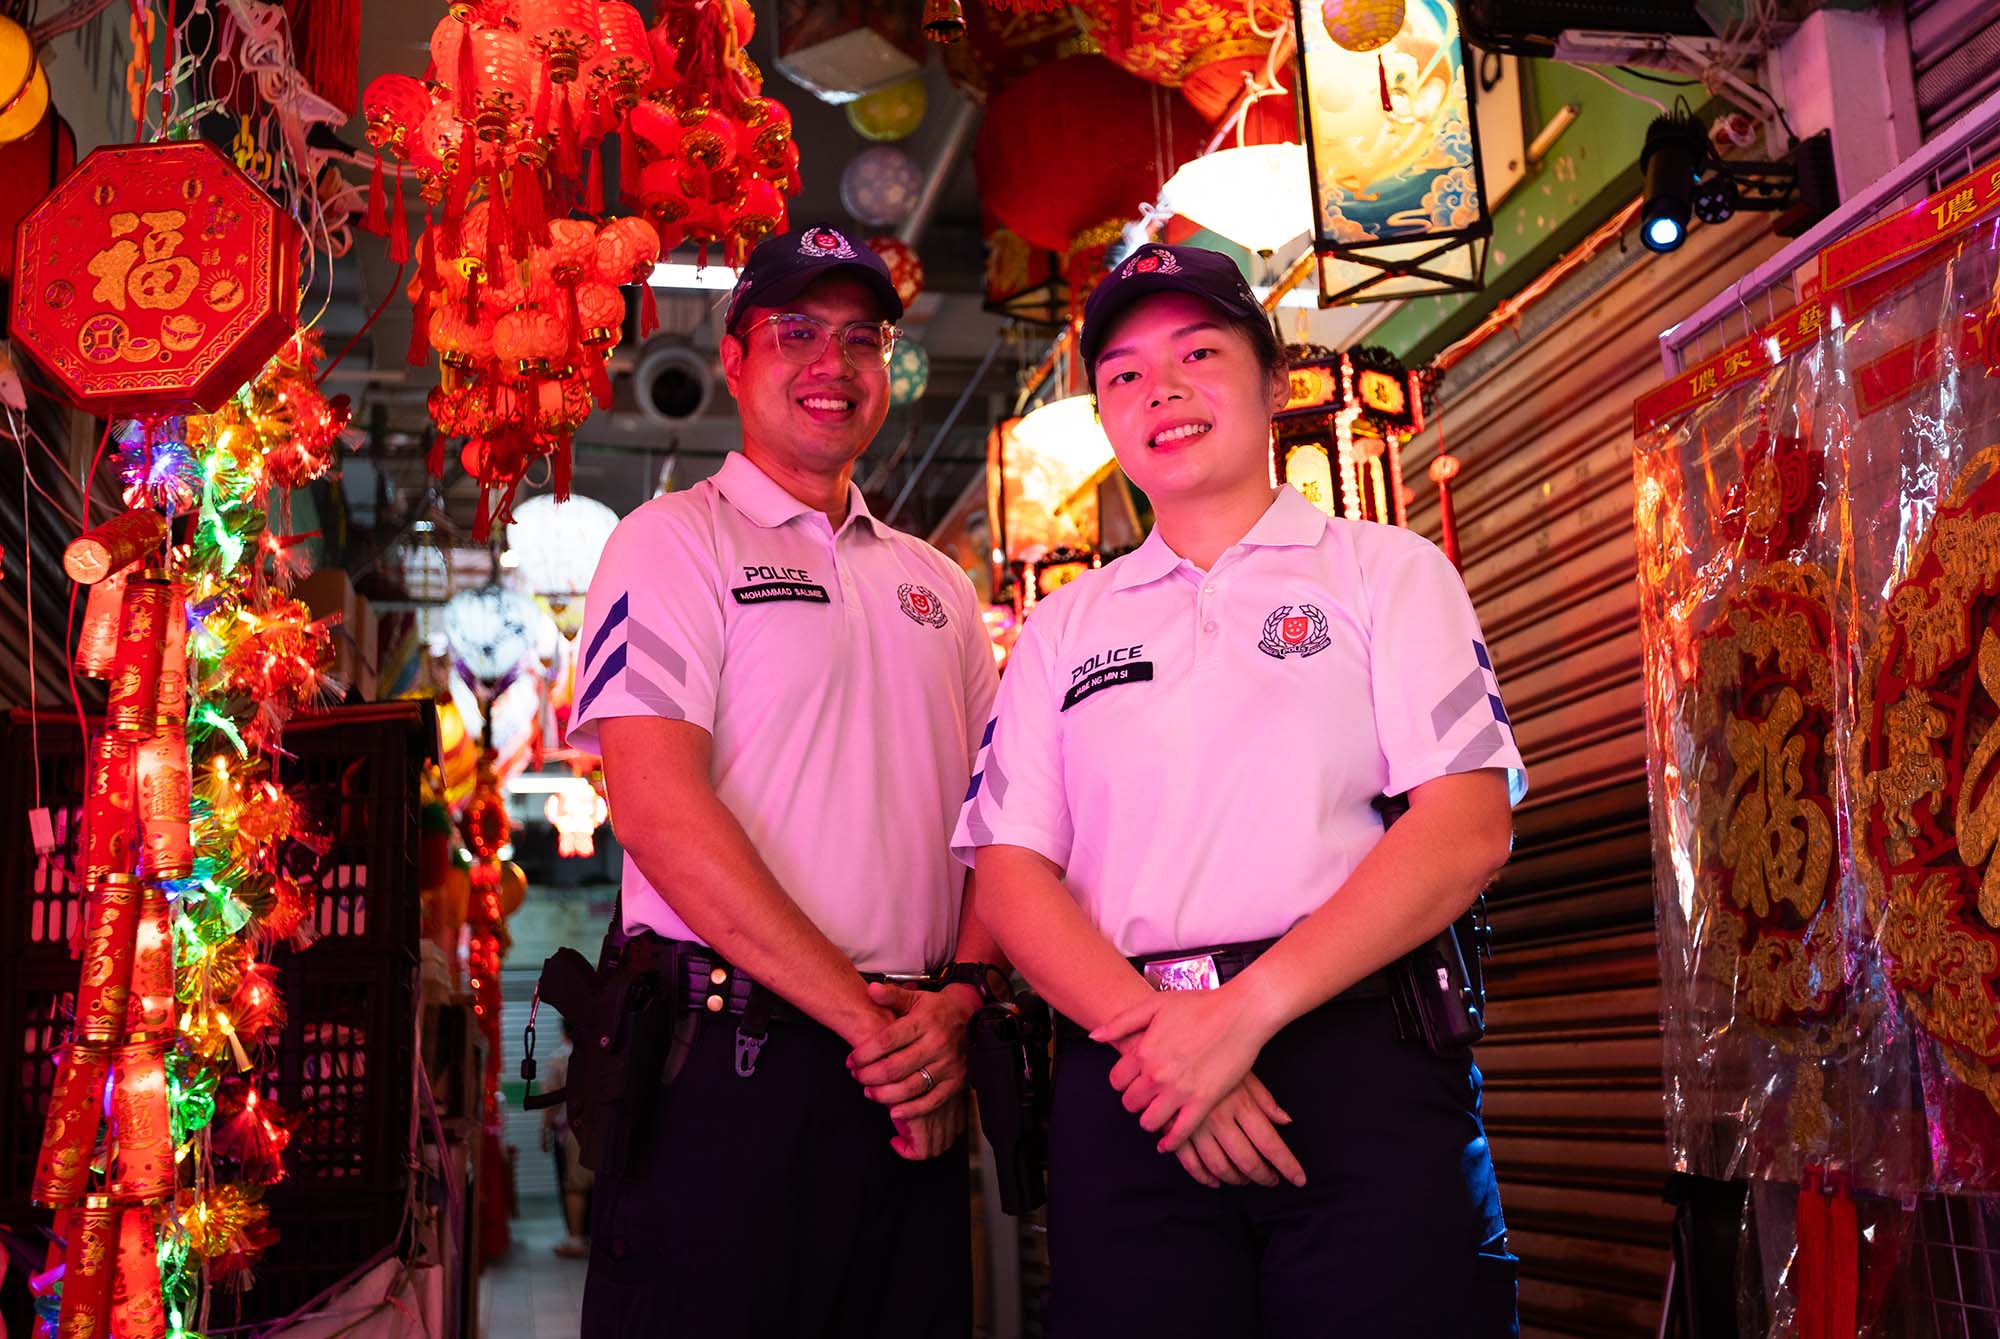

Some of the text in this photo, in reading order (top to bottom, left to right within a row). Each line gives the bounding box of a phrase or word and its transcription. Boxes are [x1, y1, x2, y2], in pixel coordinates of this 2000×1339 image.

[87, 210, 200, 311] 福
[743, 566, 813, 583] POLICE
[740, 587, 792, 600] MOHAMMAD
[1071, 644, 1143, 685] POLICE
[1091, 676, 1103, 687] NG
[1104, 671, 1119, 682] MIN
[1120, 669, 1129, 679] SI
